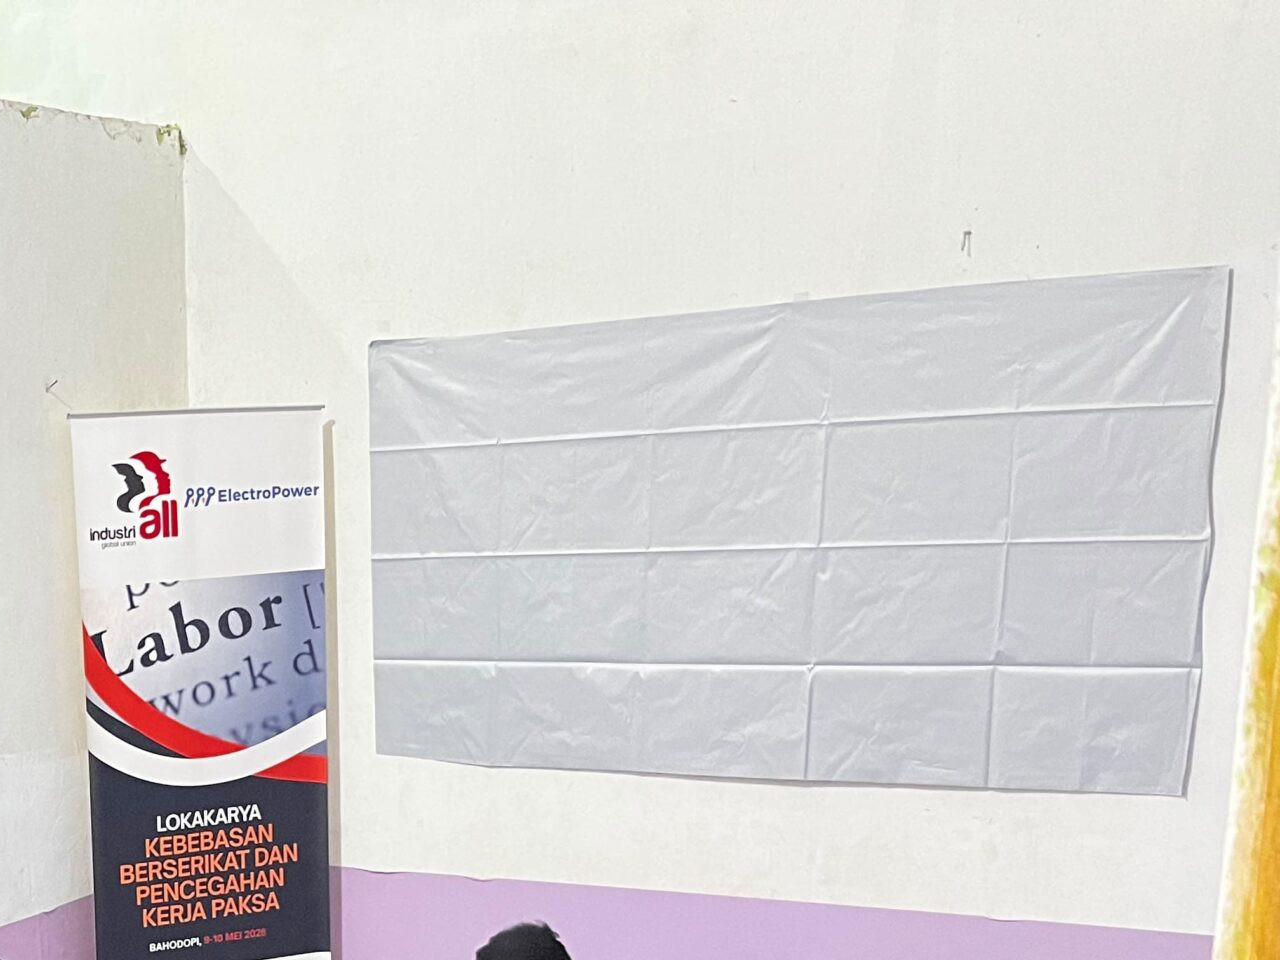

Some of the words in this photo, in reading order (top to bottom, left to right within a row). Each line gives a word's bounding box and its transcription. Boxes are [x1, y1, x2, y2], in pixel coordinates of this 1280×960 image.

[218, 484, 320, 502] ElectroPower
[90, 525, 136, 541] industri
[139, 500, 178, 539] all
[91, 595, 283, 677] Labor
[149, 656, 276, 716] work
[156, 804, 262, 833] LOKAKARYA
[145, 823, 274, 858] KEBEBASAN
[119, 849, 250, 885] BERSERIKAT
[254, 843, 298, 867] DAN
[136, 868, 285, 906] PENCEGAHAN
[142, 901, 207, 928] KERJA
[211, 892, 280, 919] PAKSA
[149, 937, 202, 952] BAHODOPI,
[225, 931, 242, 942] MEI
